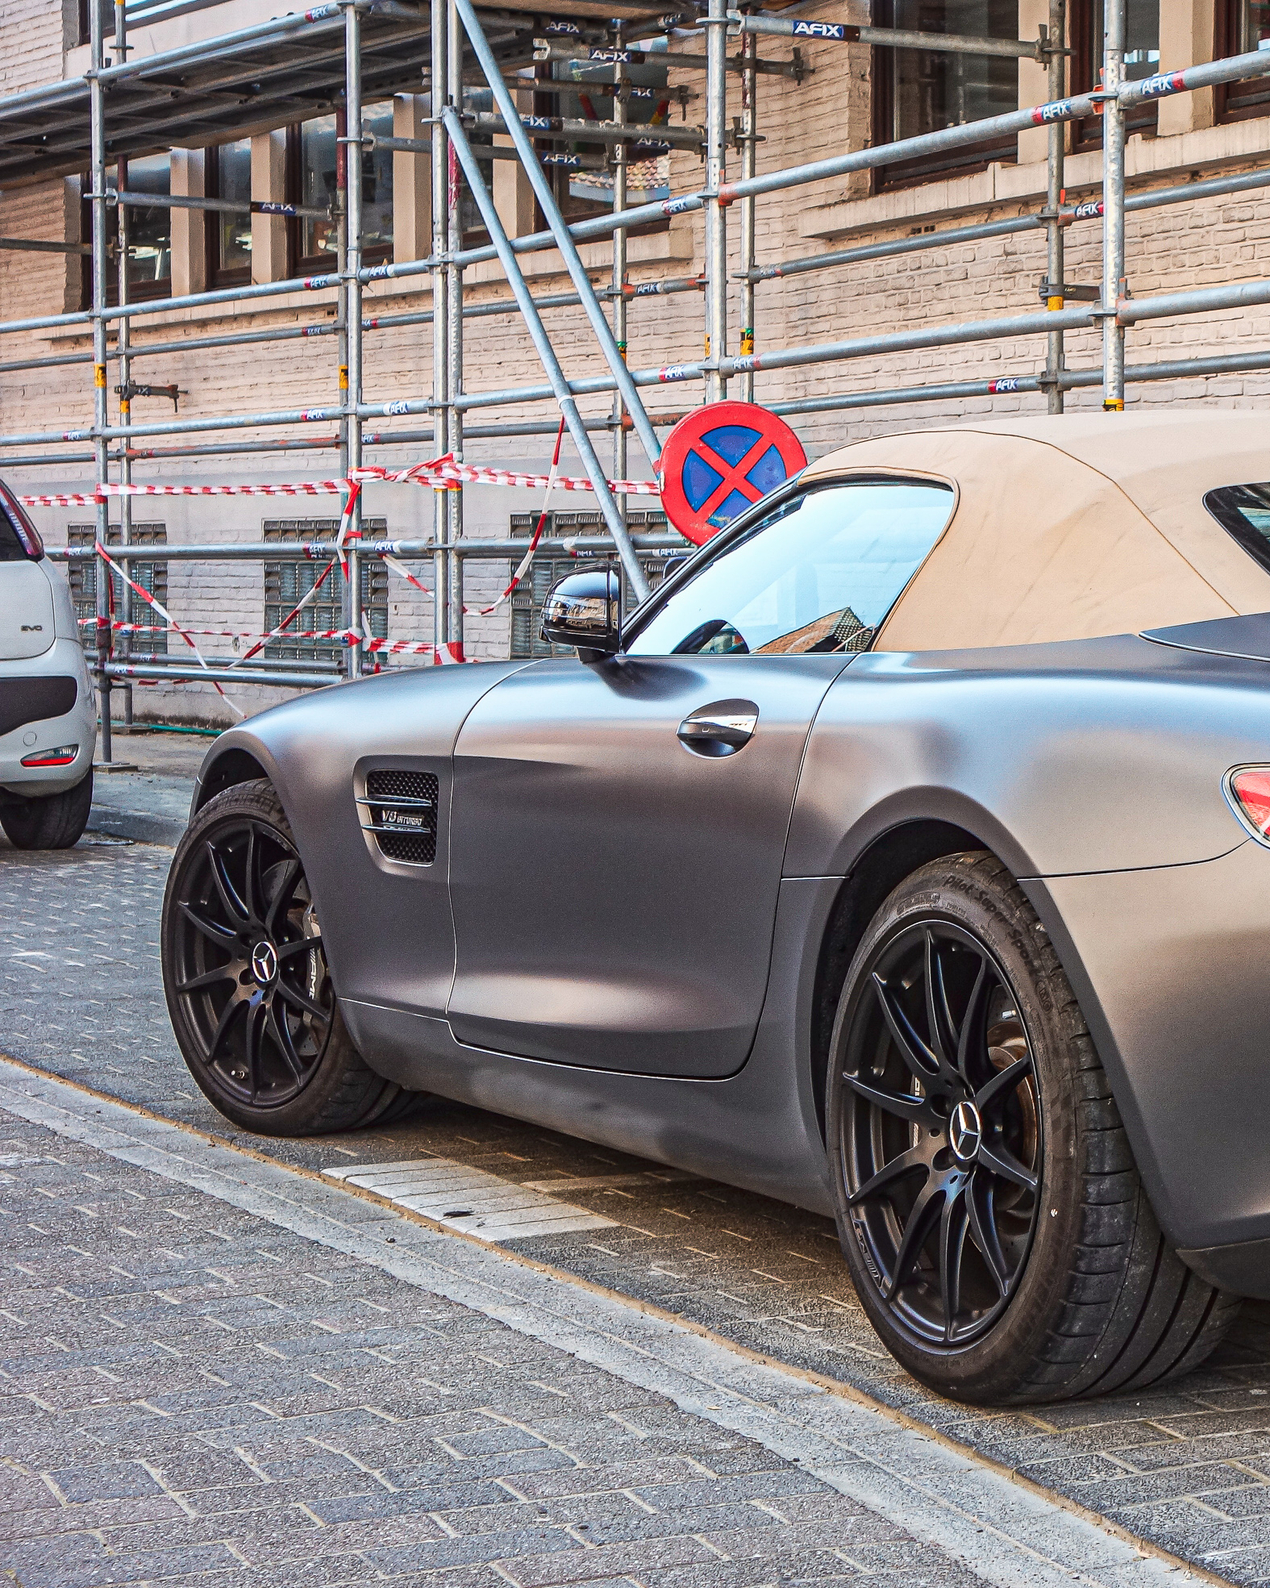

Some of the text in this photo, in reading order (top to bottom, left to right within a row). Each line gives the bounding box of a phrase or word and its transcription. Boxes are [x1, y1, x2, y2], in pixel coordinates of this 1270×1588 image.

[546, 21, 580, 33] AFIX
[794, 22, 841, 37] AFIX
[591, 53, 628, 62] AFIX
[1141, 75, 1172, 94] AFIX
[617, 87, 651, 97] FIX
[1043, 103, 1070, 119] AFIX
[520, 116, 545, 127] FIX
[637, 137, 671, 147] AFIX
[543, 154, 577, 164] AFIX
[1077, 202, 1098, 216] AFIX
[637, 283, 657, 293] AFIX
[995, 379, 1017, 390] AFIX
[306, 408, 324, 418] AFIX
[375, 541, 394, 551] AFIX
[942, 874, 976, 896] Pilot
